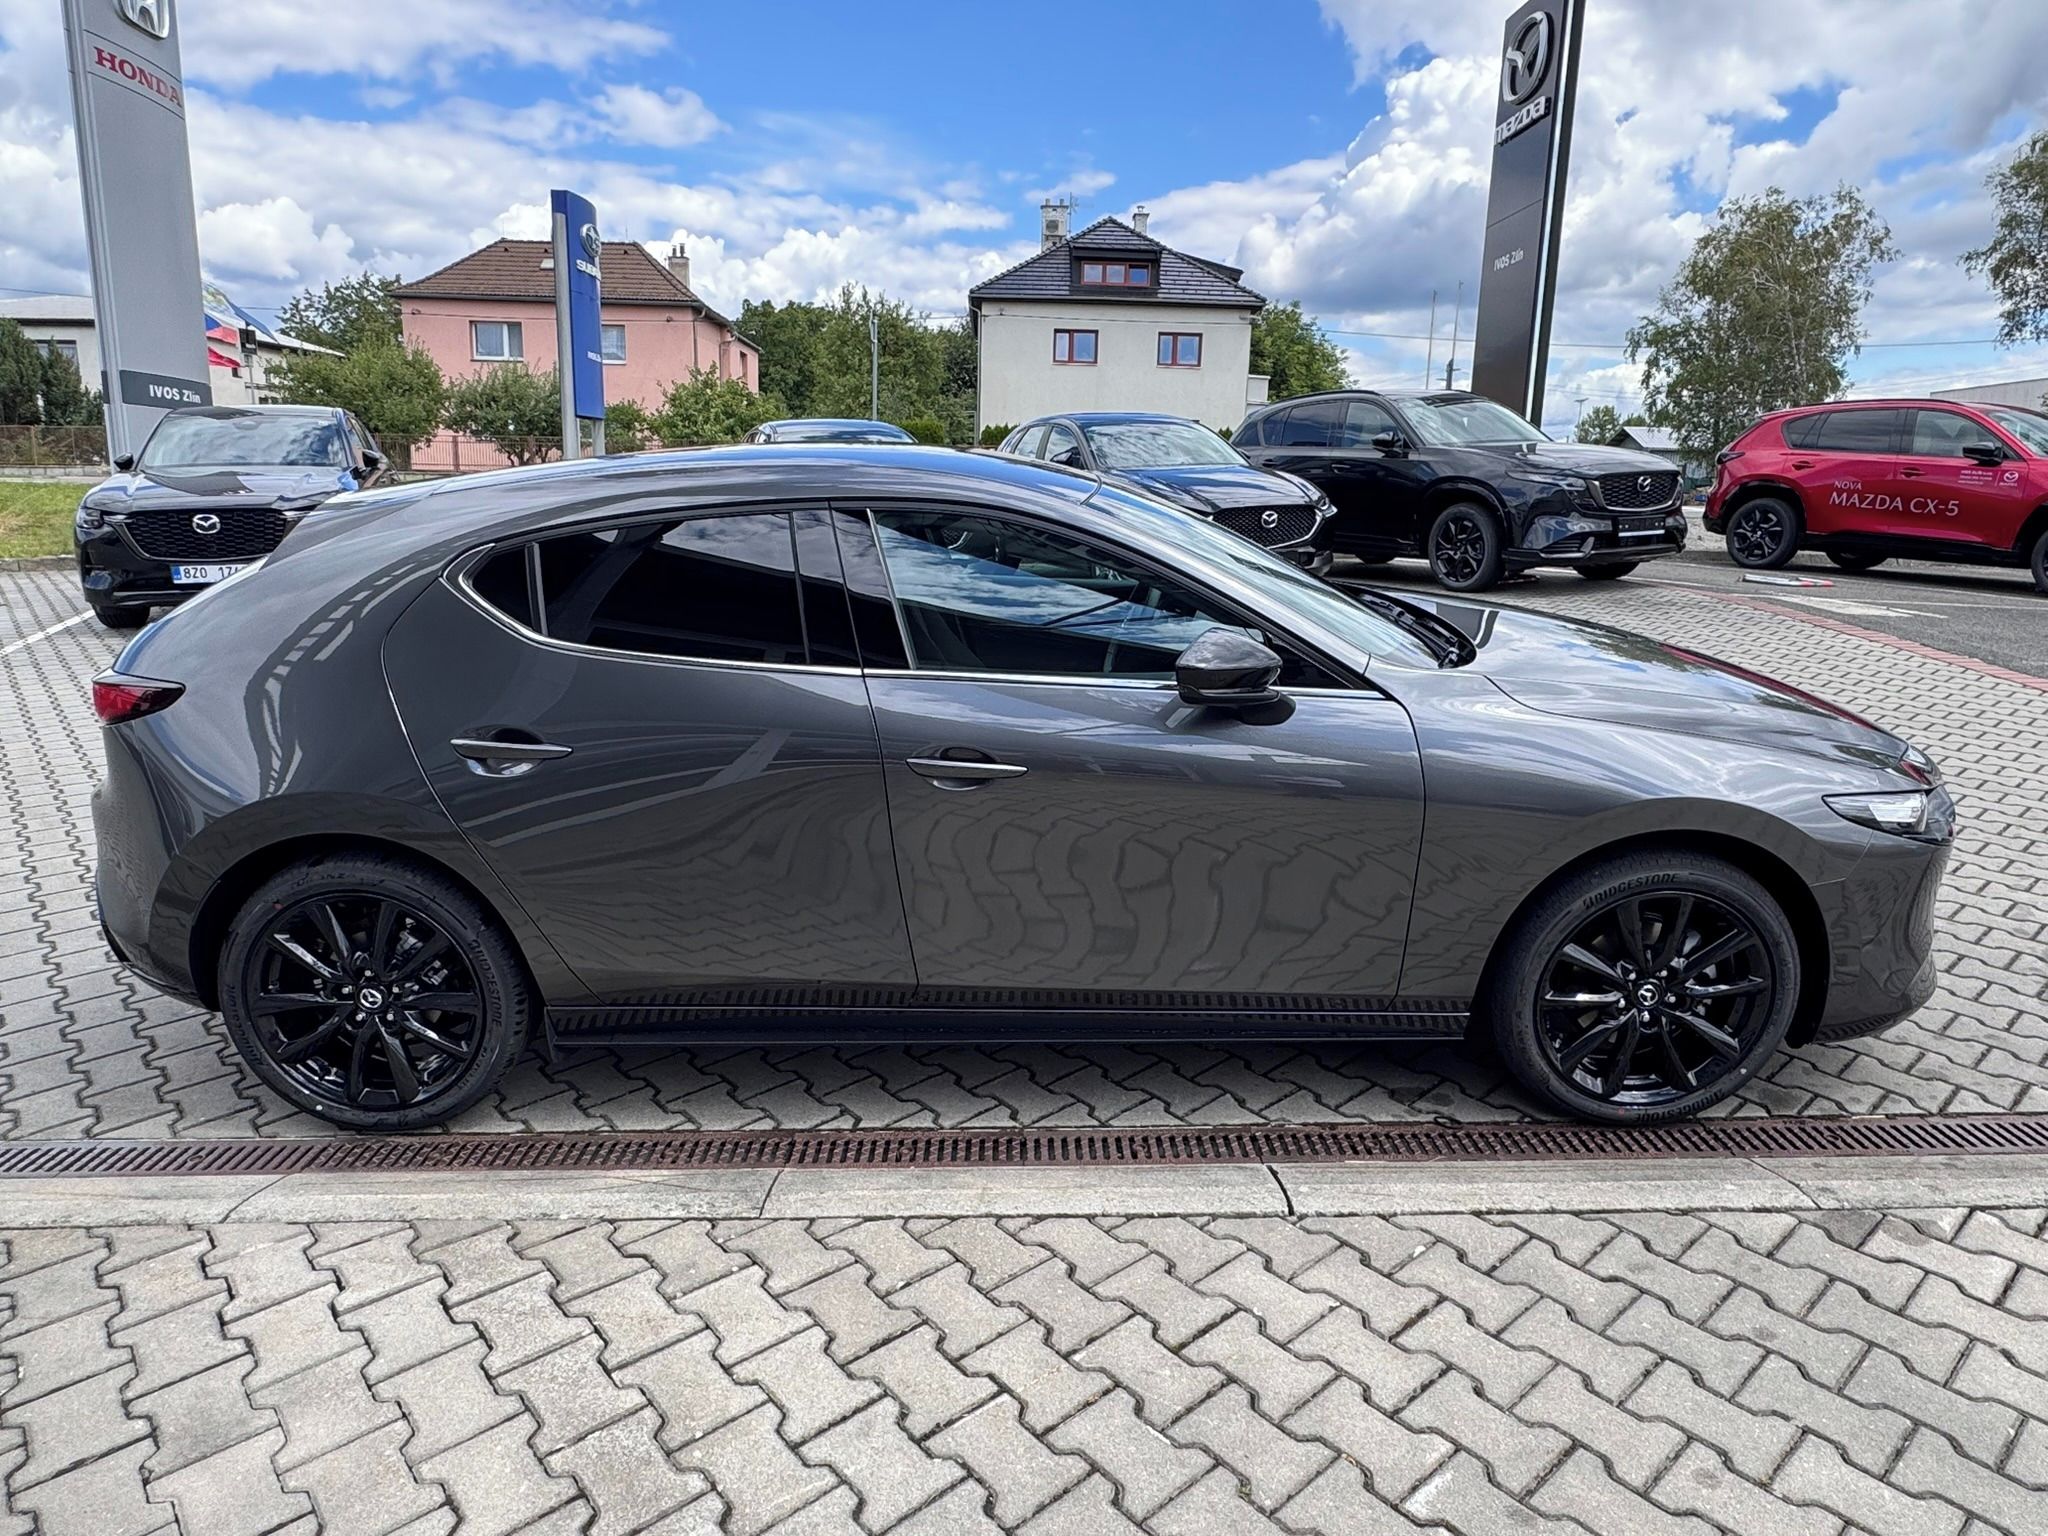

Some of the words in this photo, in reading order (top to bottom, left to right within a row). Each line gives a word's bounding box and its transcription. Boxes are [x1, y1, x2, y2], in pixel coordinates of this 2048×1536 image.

[93, 46, 183, 108] HONDA
[149, 384, 180, 401] IVOS
[1829, 491, 1904, 511] MAZDA
[1909, 497, 1960, 516] CX-5
[218, 566, 241, 579] 17
[1582, 873, 1681, 910] BRIDGESTONE
